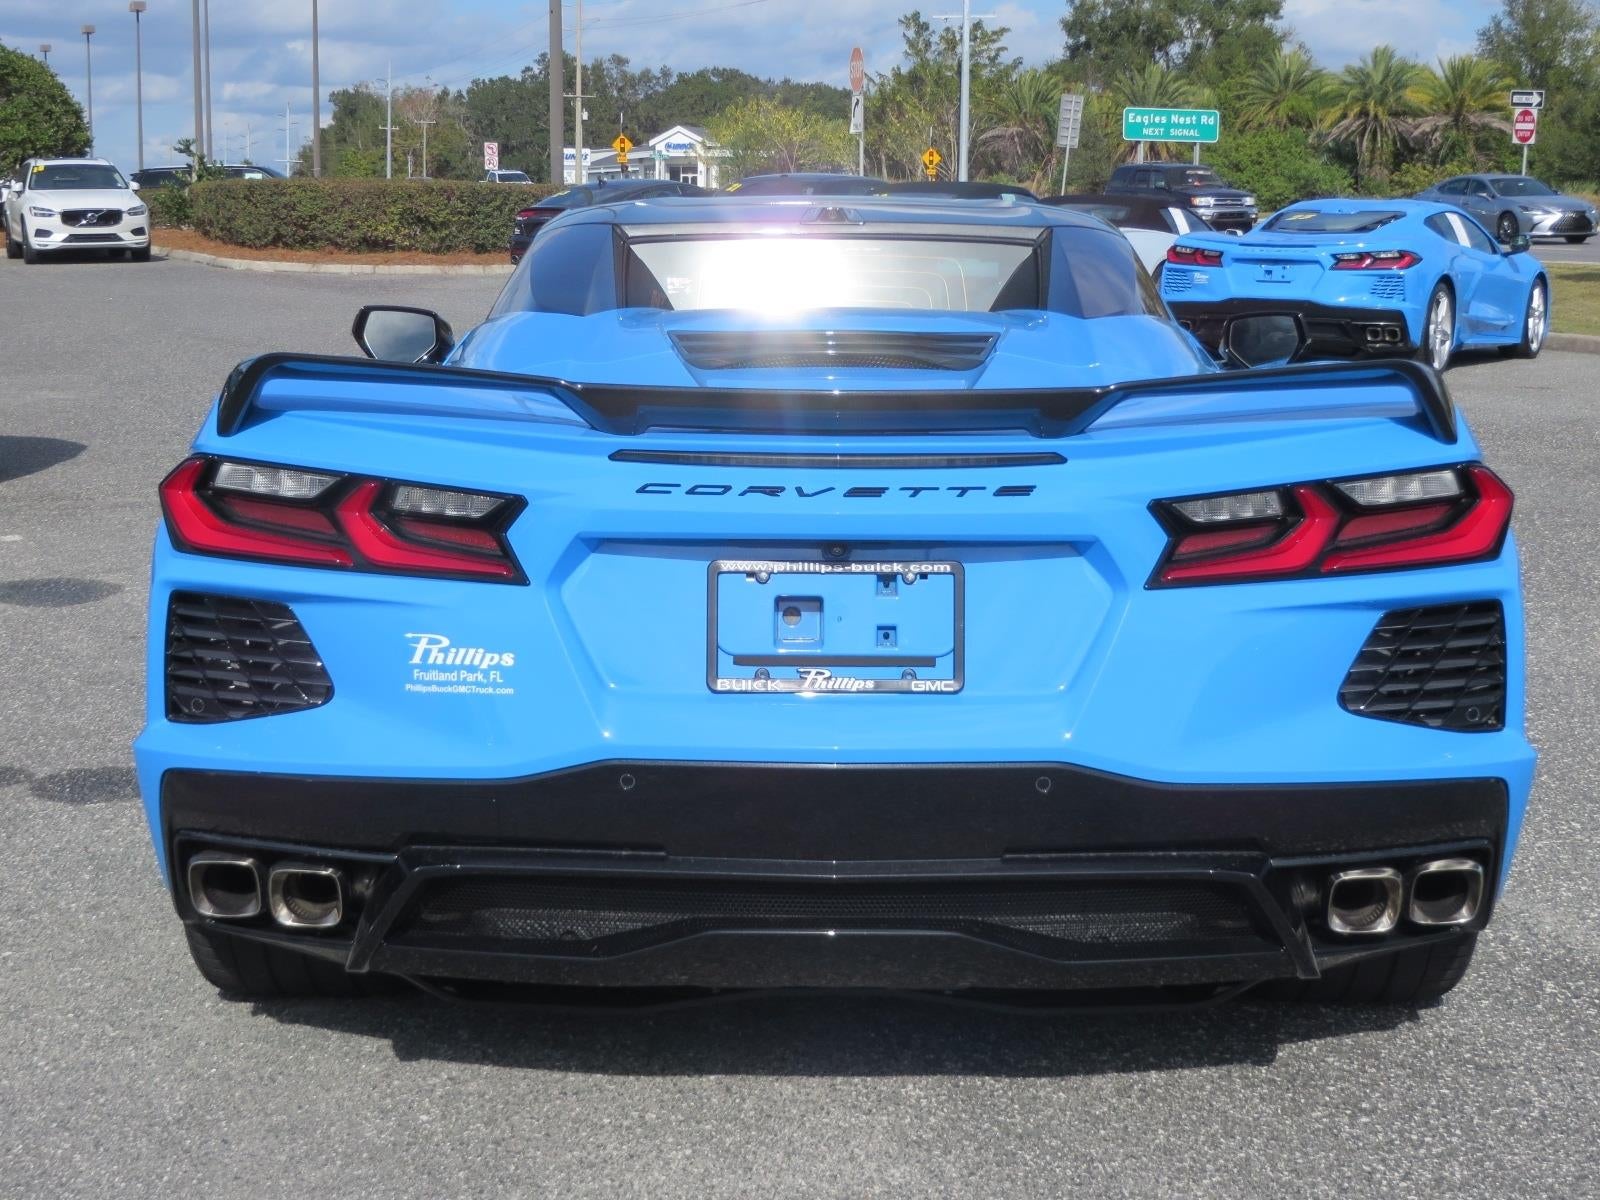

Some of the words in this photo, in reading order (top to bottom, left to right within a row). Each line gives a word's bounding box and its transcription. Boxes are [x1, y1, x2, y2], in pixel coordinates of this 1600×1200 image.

[1128, 112, 1167, 126] Eagles
[1170, 114, 1197, 125] Nest
[1200, 115, 1214, 125] Rd
[1142, 127, 1164, 136] NEXT
[1169, 128, 1200, 137] SIGNAL
[635, 482, 1038, 498] CORVETTE
[720, 561, 951, 574] www.phillips-buick.com
[403, 632, 515, 669] Phillips
[413, 669, 458, 681] Fruitland
[460, 670, 487, 683] Park,
[490, 671, 503, 682] FL
[716, 679, 781, 691] BUICK
[796, 667, 875, 691] Phillips
[911, 680, 954, 691] GMC
